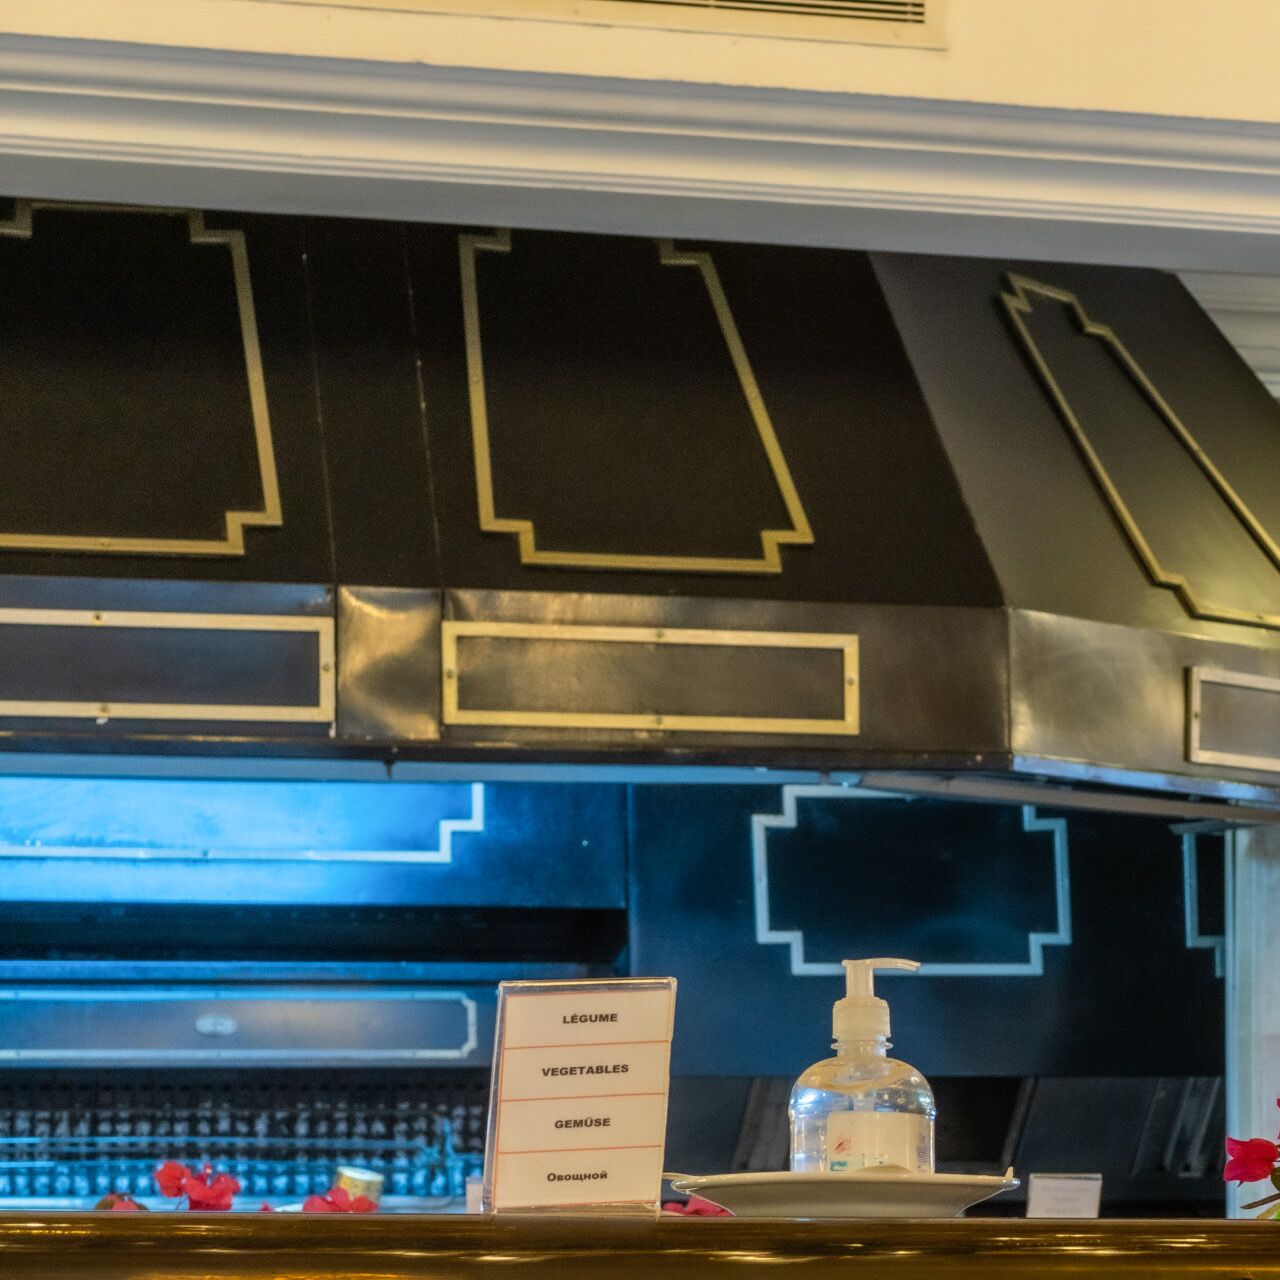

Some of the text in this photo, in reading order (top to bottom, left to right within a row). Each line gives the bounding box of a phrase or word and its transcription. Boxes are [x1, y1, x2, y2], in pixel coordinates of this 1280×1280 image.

[562, 1012, 618, 1025] LÉGUME
[541, 1064, 630, 1077] VEGETABLES
[554, 1116, 611, 1129] GEMÜSE
[546, 1169, 608, 1183] Овощной
